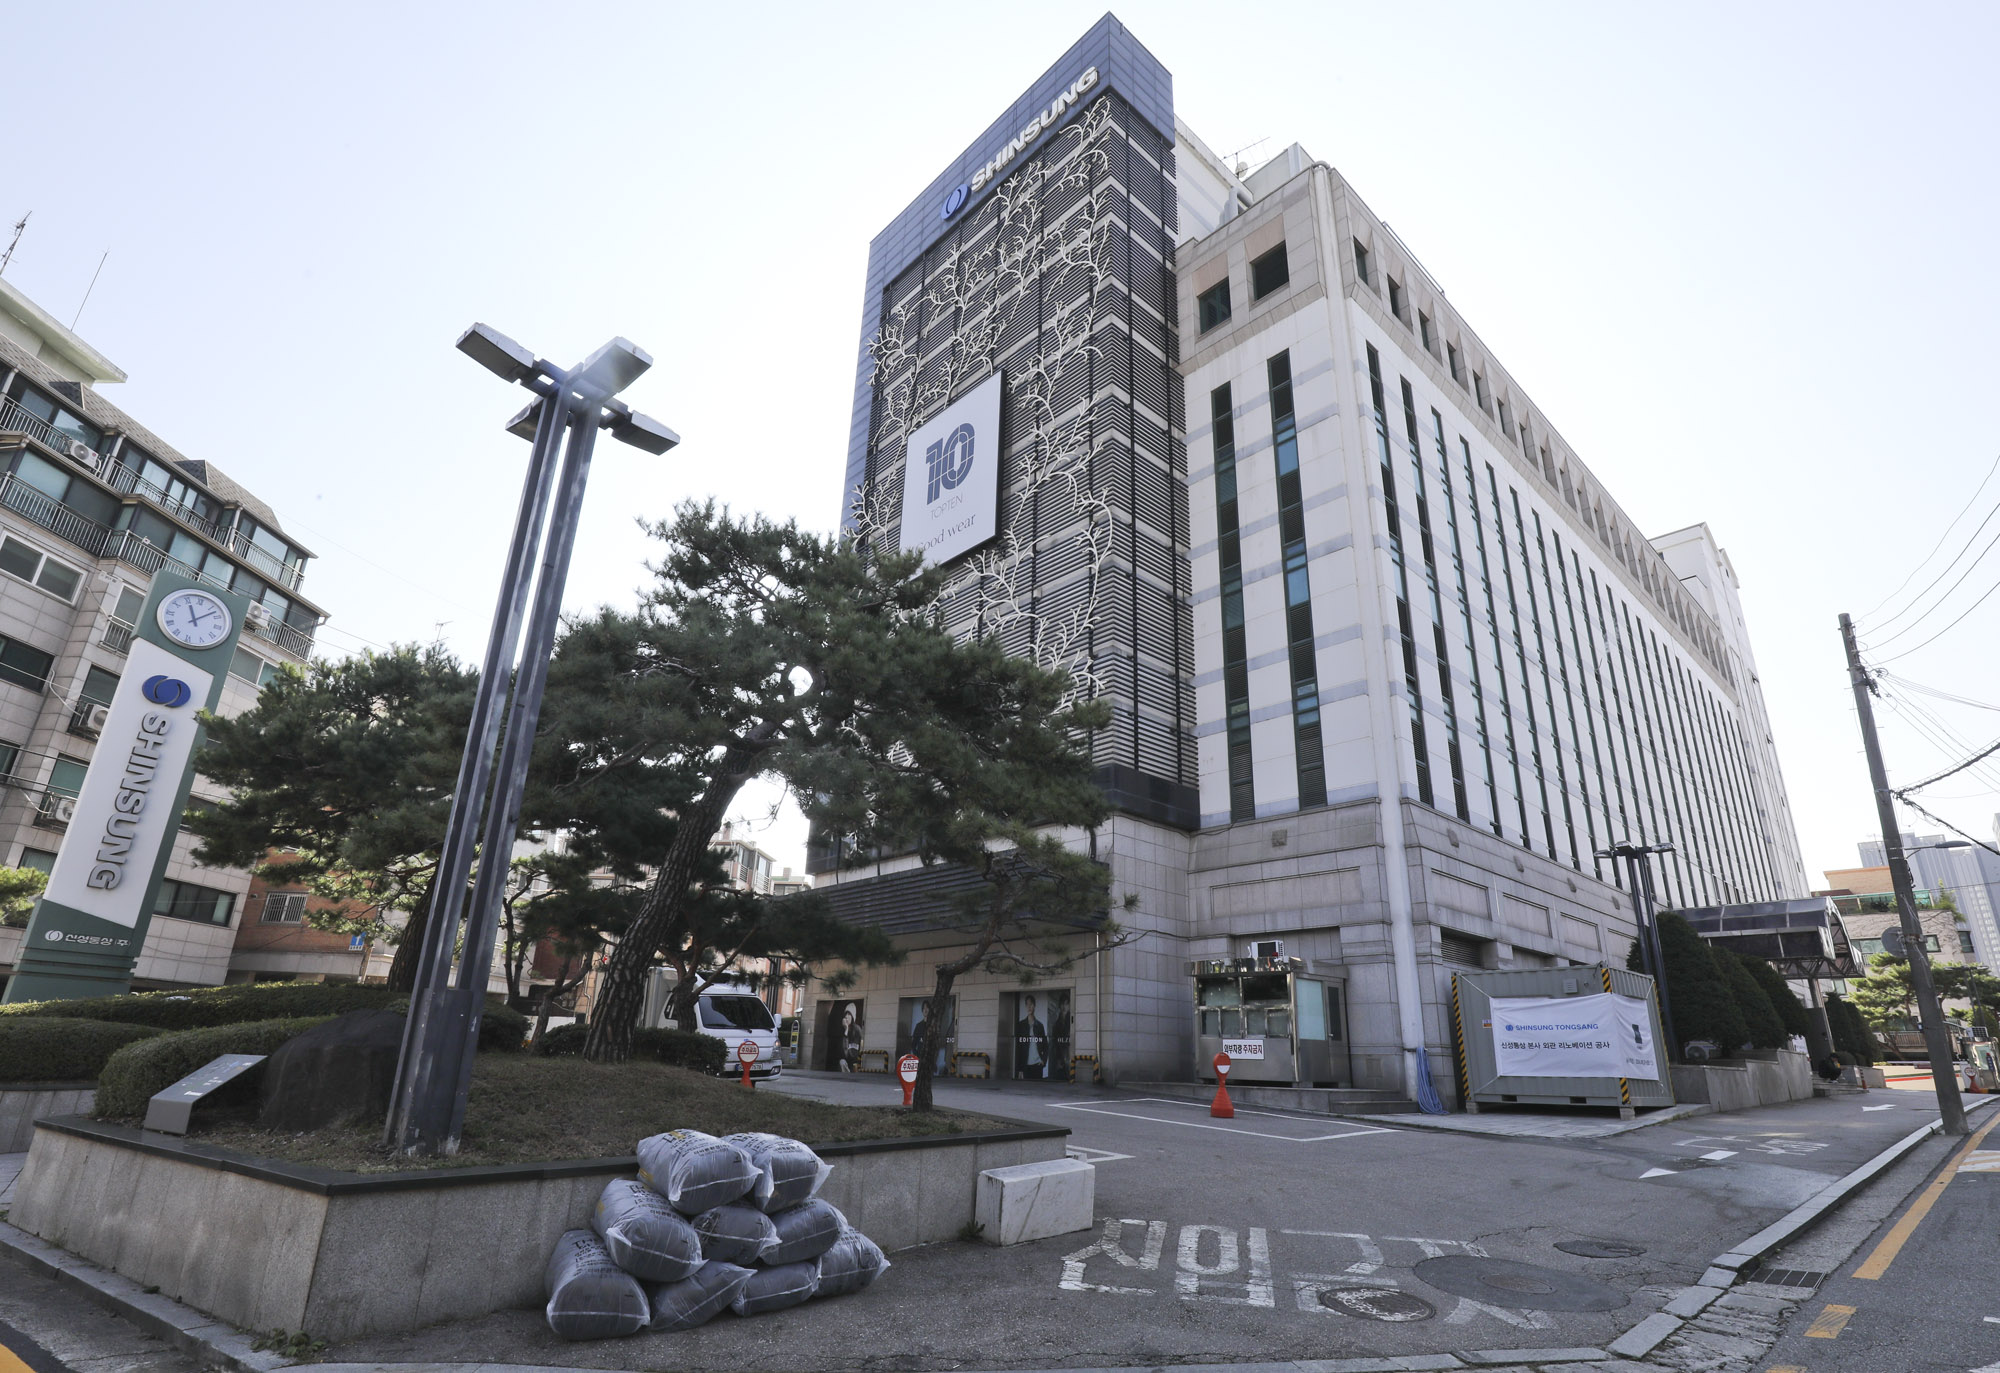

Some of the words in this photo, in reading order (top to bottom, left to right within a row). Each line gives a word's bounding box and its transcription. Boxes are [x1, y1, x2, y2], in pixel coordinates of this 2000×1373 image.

[971, 66, 1098, 192] SHINSUNG
[926, 422, 975, 506] 10
[931, 493, 963, 520] TOPTEN
[947, 514, 977, 539] wear
[87, 711, 173, 891] SHINSUNG
[1555, 1023, 1599, 1031] TONGSANG
[1243, 1044, 1262, 1054] 주차금지
[1501, 1041, 1526, 1049] 신성통상
[1558, 1041, 1593, 1049] 리노베이션
[1595, 1041, 1610, 1049] 공사
